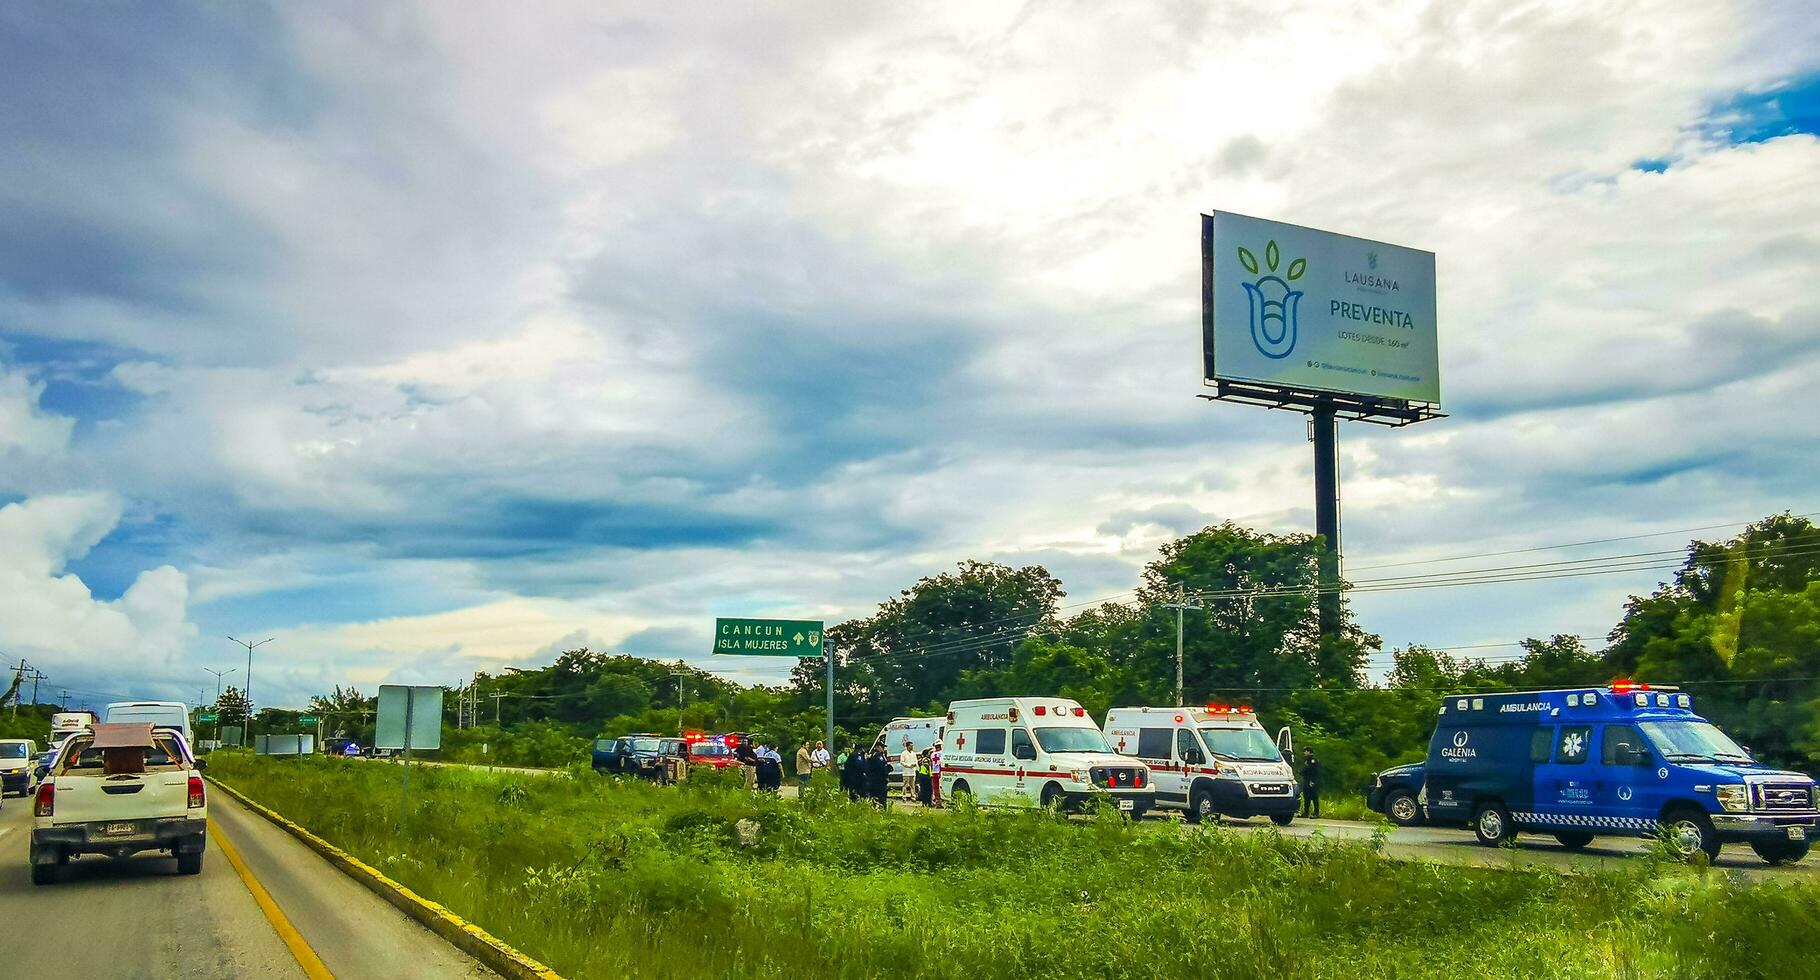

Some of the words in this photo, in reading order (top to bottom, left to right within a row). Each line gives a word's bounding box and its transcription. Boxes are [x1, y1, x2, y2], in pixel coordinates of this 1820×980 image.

[1345, 271, 1399, 291] LAUSANA
[1330, 299, 1413, 329] PREVENTA
[1338, 331, 1360, 342] LOTES
[1361, 334, 1385, 345] DESDE
[722, 624, 782, 636] CANCUN
[718, 639, 740, 649] ISLA
[744, 639, 788, 650] MUJERES
[1499, 701, 1552, 713] AMBULANCIA
[980, 713, 1009, 721] AMBULANCIA
[1441, 747, 1477, 758] GALENIA
[1660, 769, 1666, 777] 6
